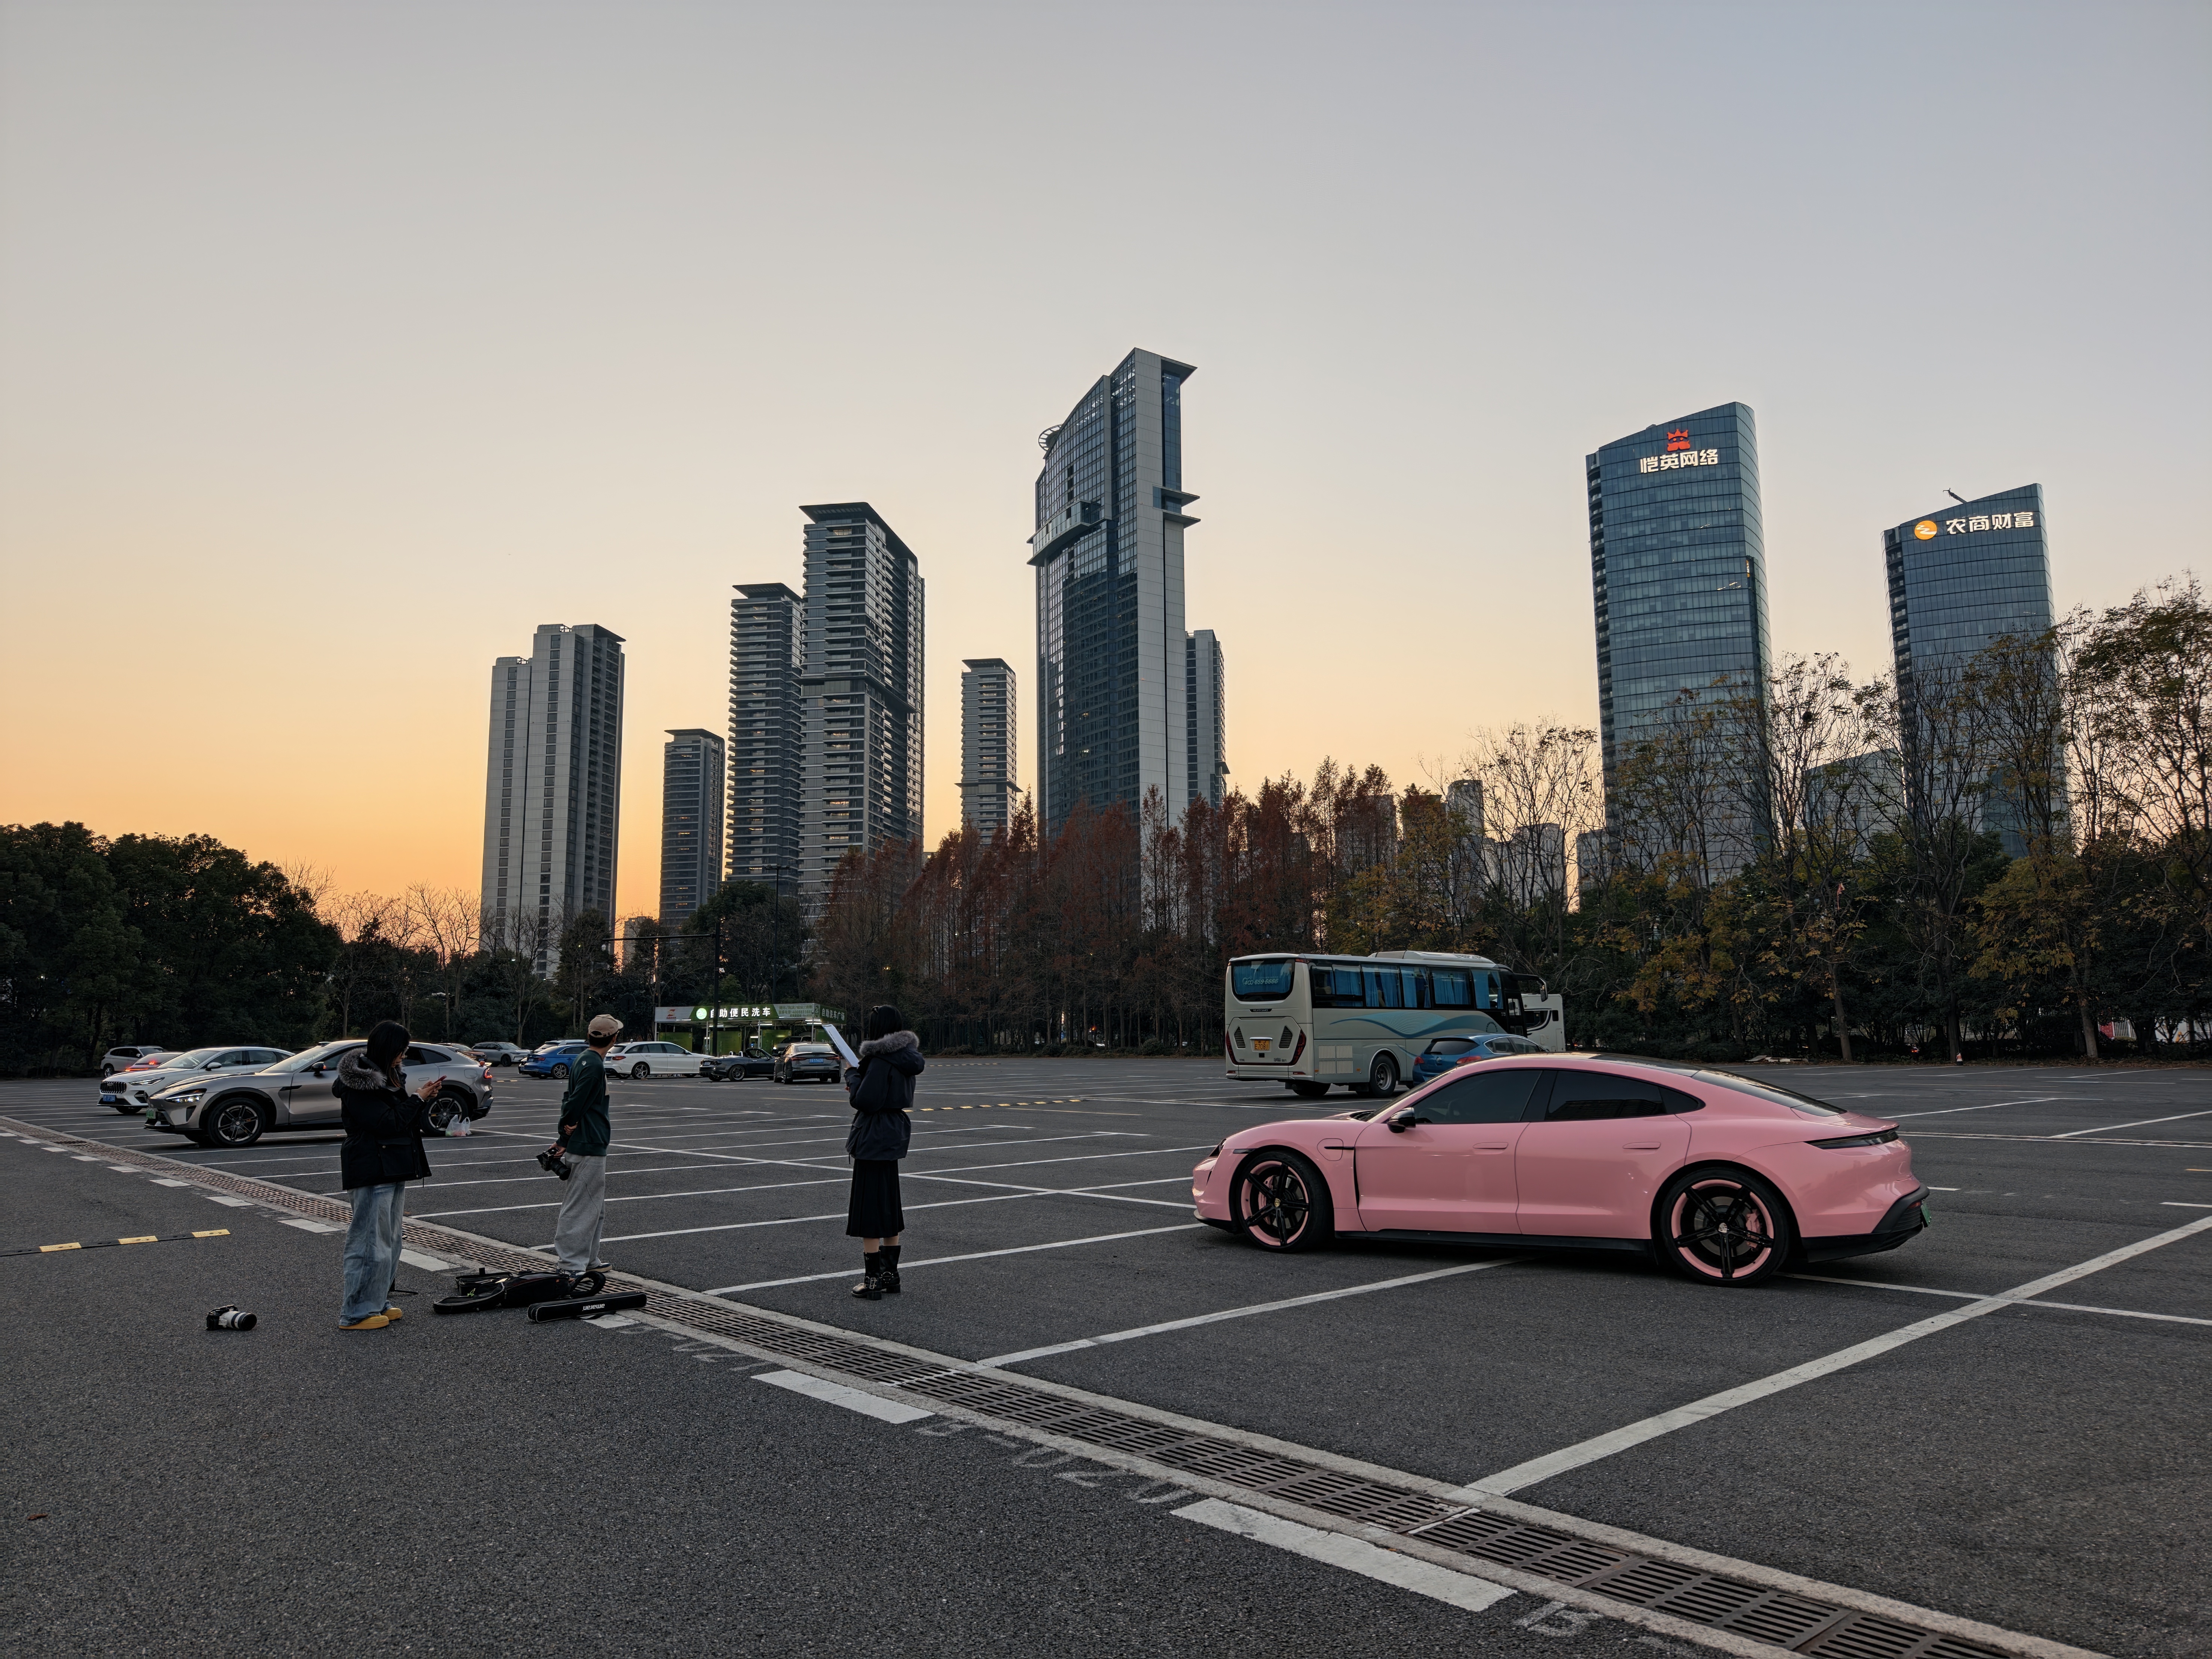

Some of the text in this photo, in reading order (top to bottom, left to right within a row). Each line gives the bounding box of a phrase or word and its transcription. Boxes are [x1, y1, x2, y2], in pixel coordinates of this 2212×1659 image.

[1640, 449, 1718, 473] 恺英网络
[1946, 512, 2034, 534] 农商财富
[710, 1007, 771, 1018] 自助便民洗车
[822, 1008, 845, 1021] 自助洗车广场
